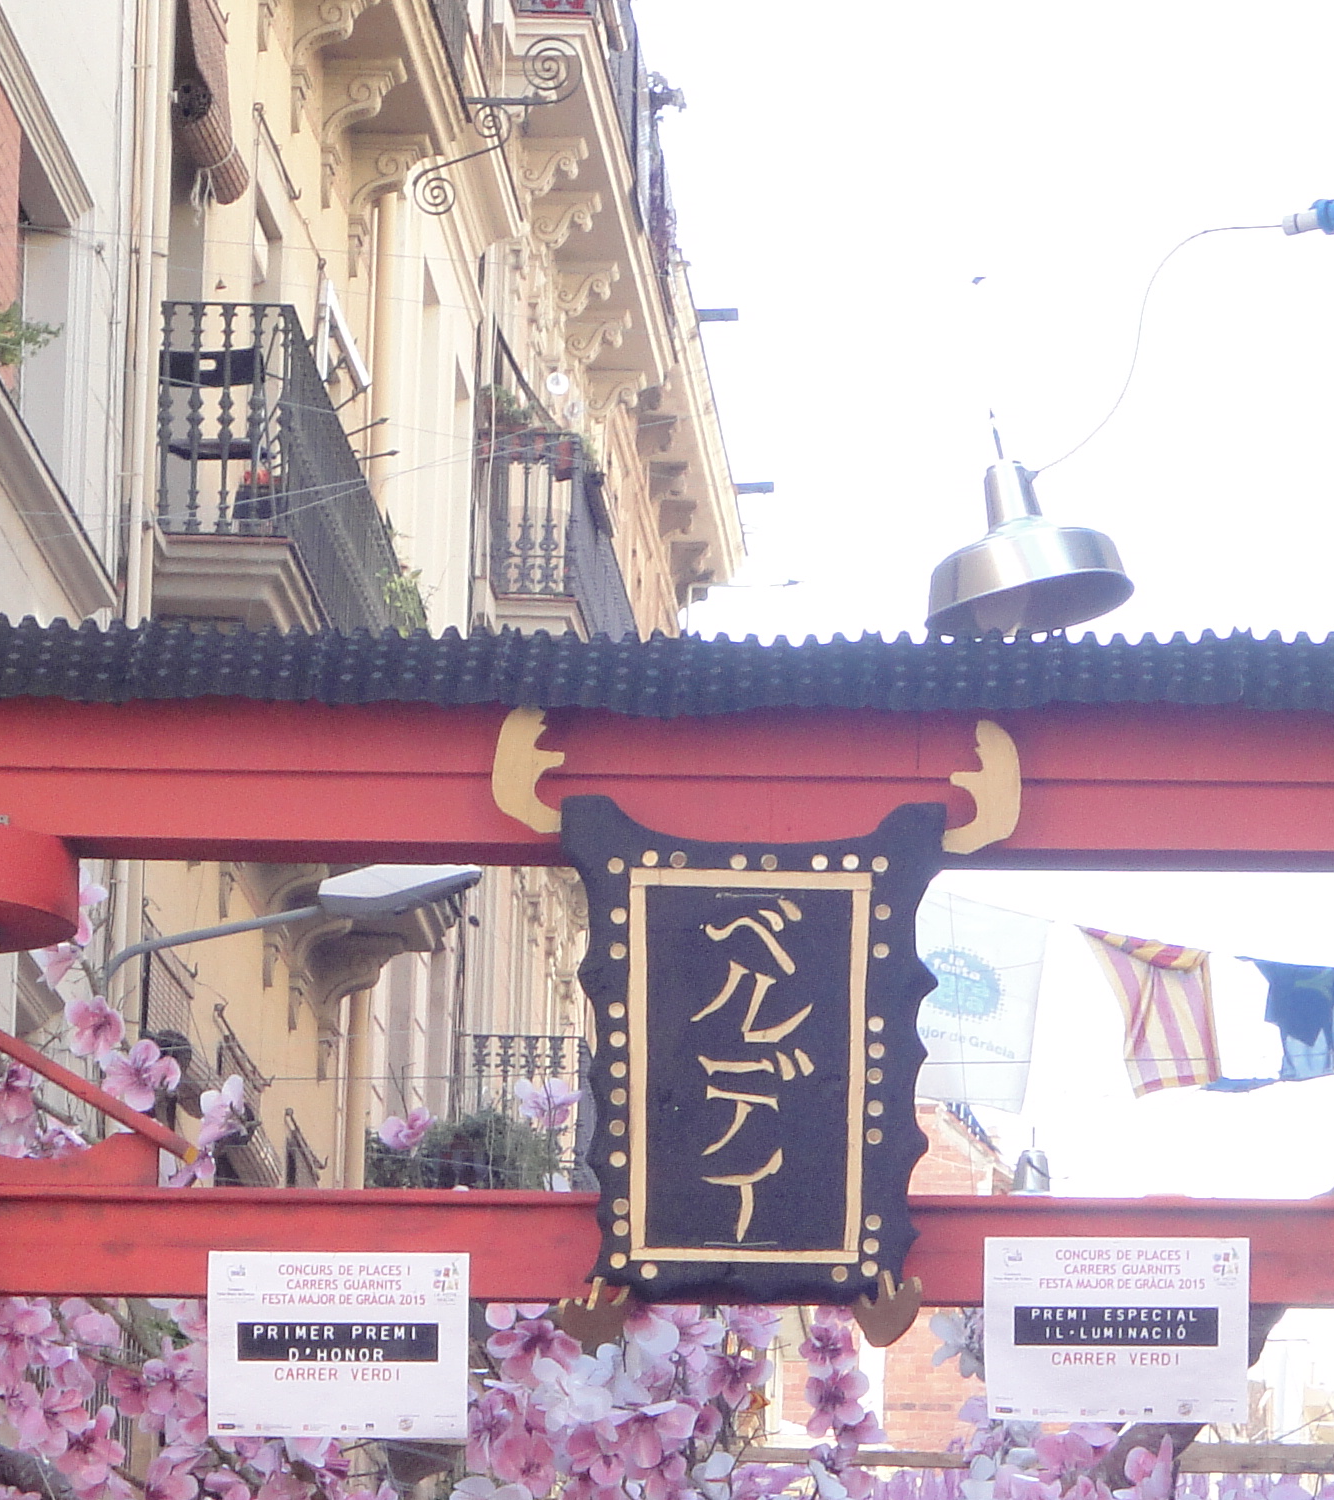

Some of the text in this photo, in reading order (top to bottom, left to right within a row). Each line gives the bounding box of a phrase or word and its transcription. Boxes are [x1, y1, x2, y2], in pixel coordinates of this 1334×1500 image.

[949, 1031, 966, 1044] de
[1056, 1250, 1189, 1260] CONCURS DE PLACES I
[279, 1265, 410, 1276] CONCURS DE PLACES I
[1064, 1265, 1180, 1275] CARRERS GUARNITS
[287, 1280, 402, 1290] CARRERS GUARNITS
[1039, 1279, 1072, 1288] FESTA
[1077, 1279, 1114, 1289] MAJOR
[1118, 1279, 1132, 1289] DE
[1135, 1277, 1175, 1289] GRÀCIA
[1179, 1279, 1205, 1290] 2015
[262, 1294, 294, 1305] FESTA
[298, 1294, 335, 1305] MAJOR
[339, 1294, 353, 1305] DE
[357, 1293, 395, 1305] GRÀCIA
[399, 1295, 425, 1306] 2015
[1031, 1309, 1197, 1321] PREMI ESPECIAL
[253, 1325, 416, 1340] PRIMER PREMI
[289, 1348, 384, 1362] D'HONOR
[1052, 1352, 1179, 1366] CARRER VERDI
[275, 1368, 400, 1381] CARRER VERDI
